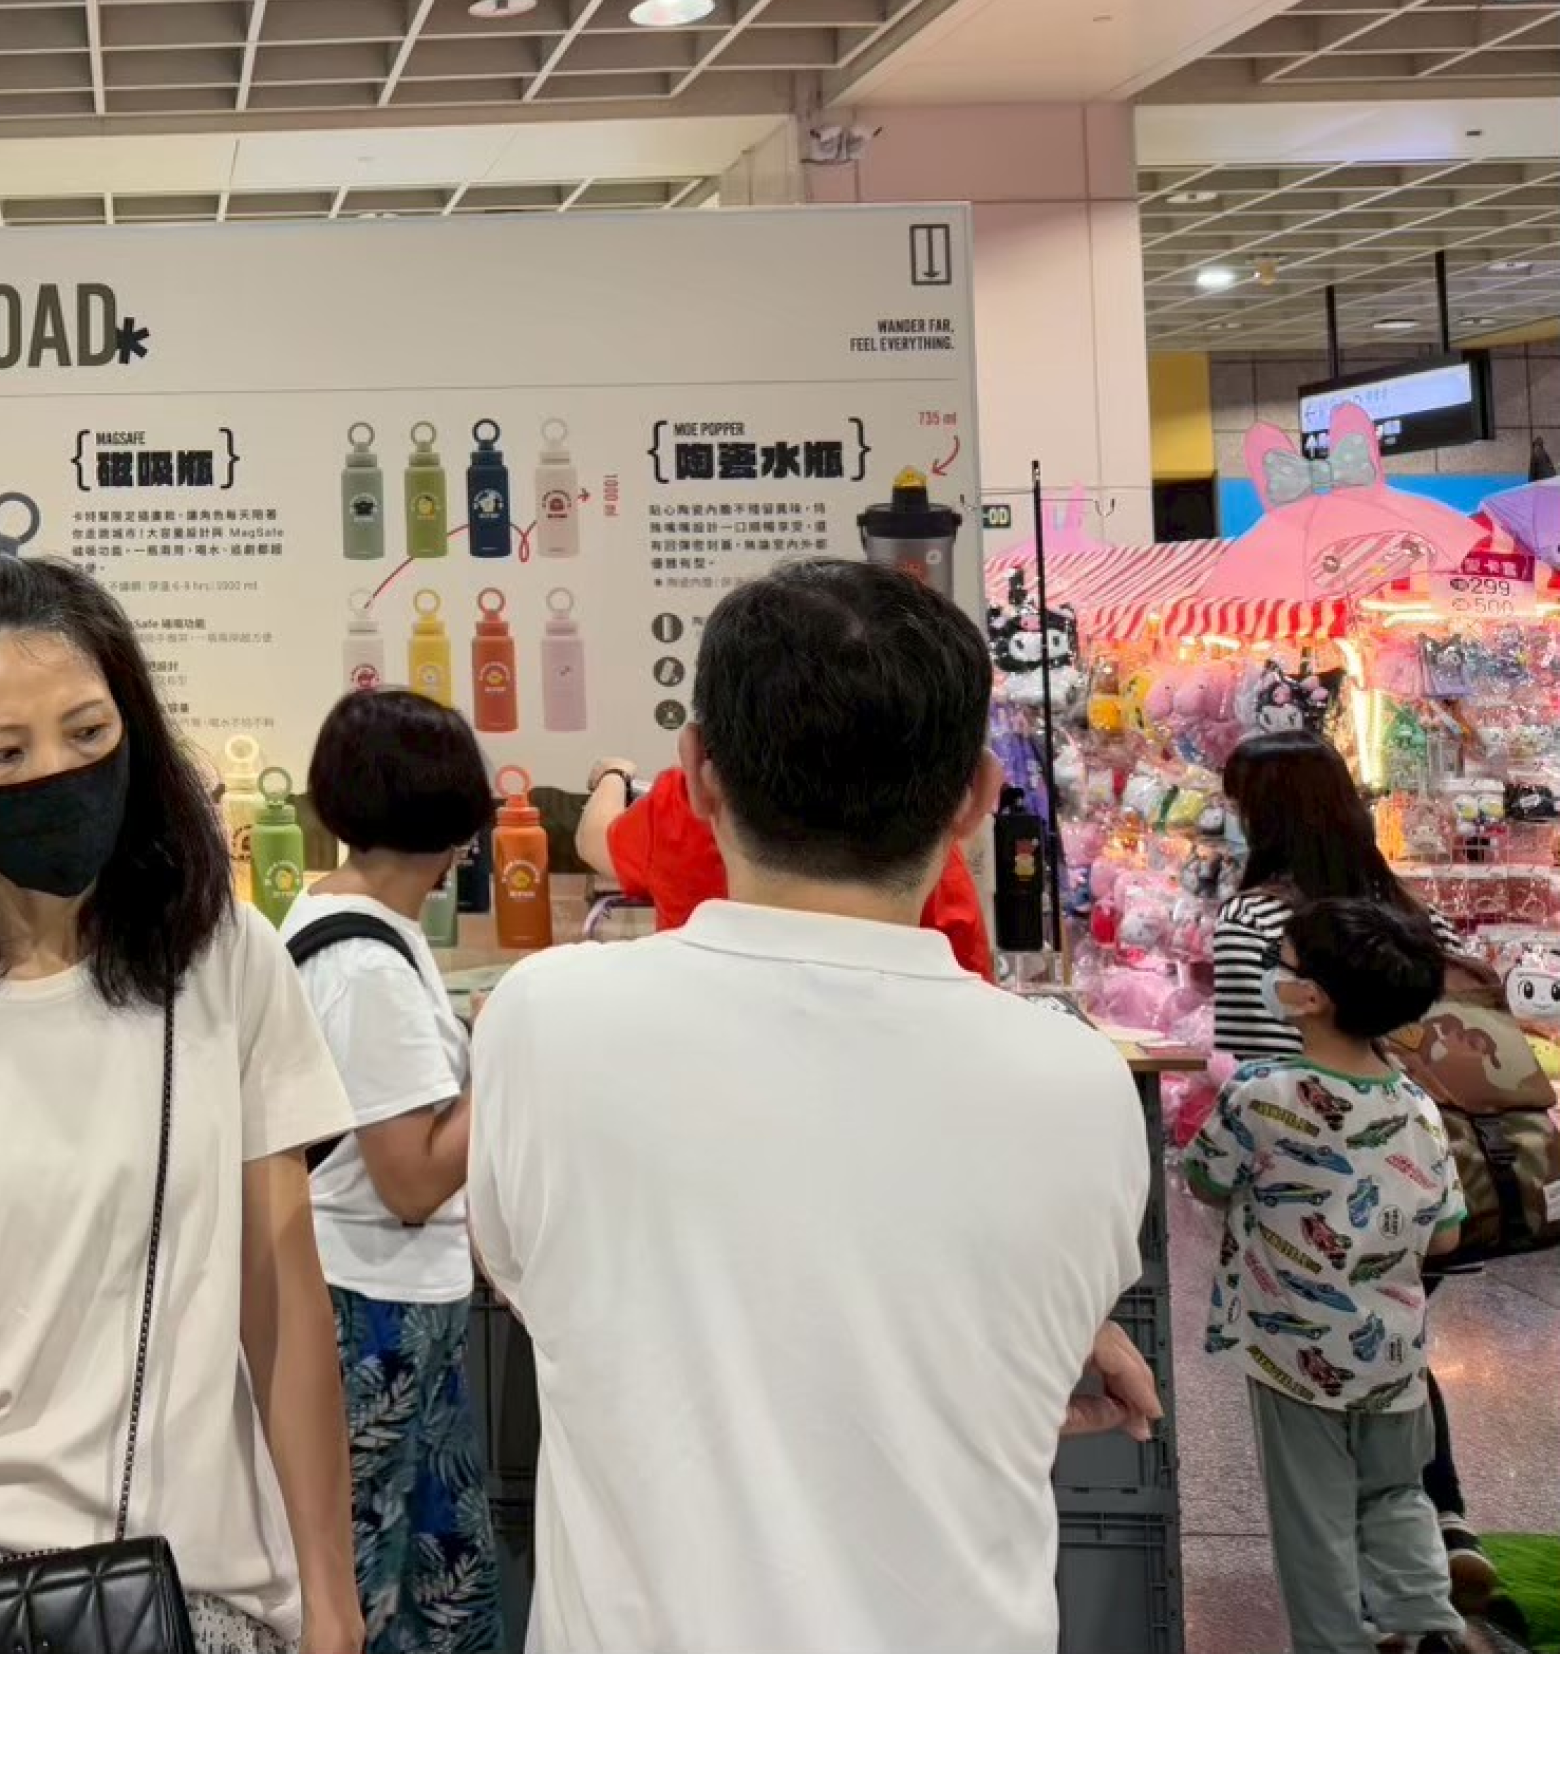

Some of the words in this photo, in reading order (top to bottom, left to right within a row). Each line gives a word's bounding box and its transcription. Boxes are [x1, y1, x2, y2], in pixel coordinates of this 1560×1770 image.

[877, 319, 925, 332] WANDER
[928, 319, 954, 332] FAR.
[850, 337, 878, 351] FEEL
[880, 336, 954, 351] EVERYTHING.
[674, 422, 698, 436] MOE
[701, 422, 744, 436] POPPER
[96, 431, 145, 445] MAGSAFE
[675, 441, 843, 480] 陶瓷水瓶
[96, 450, 213, 487] 磁吸瓶
[229, 528, 284, 540] MagSafe
